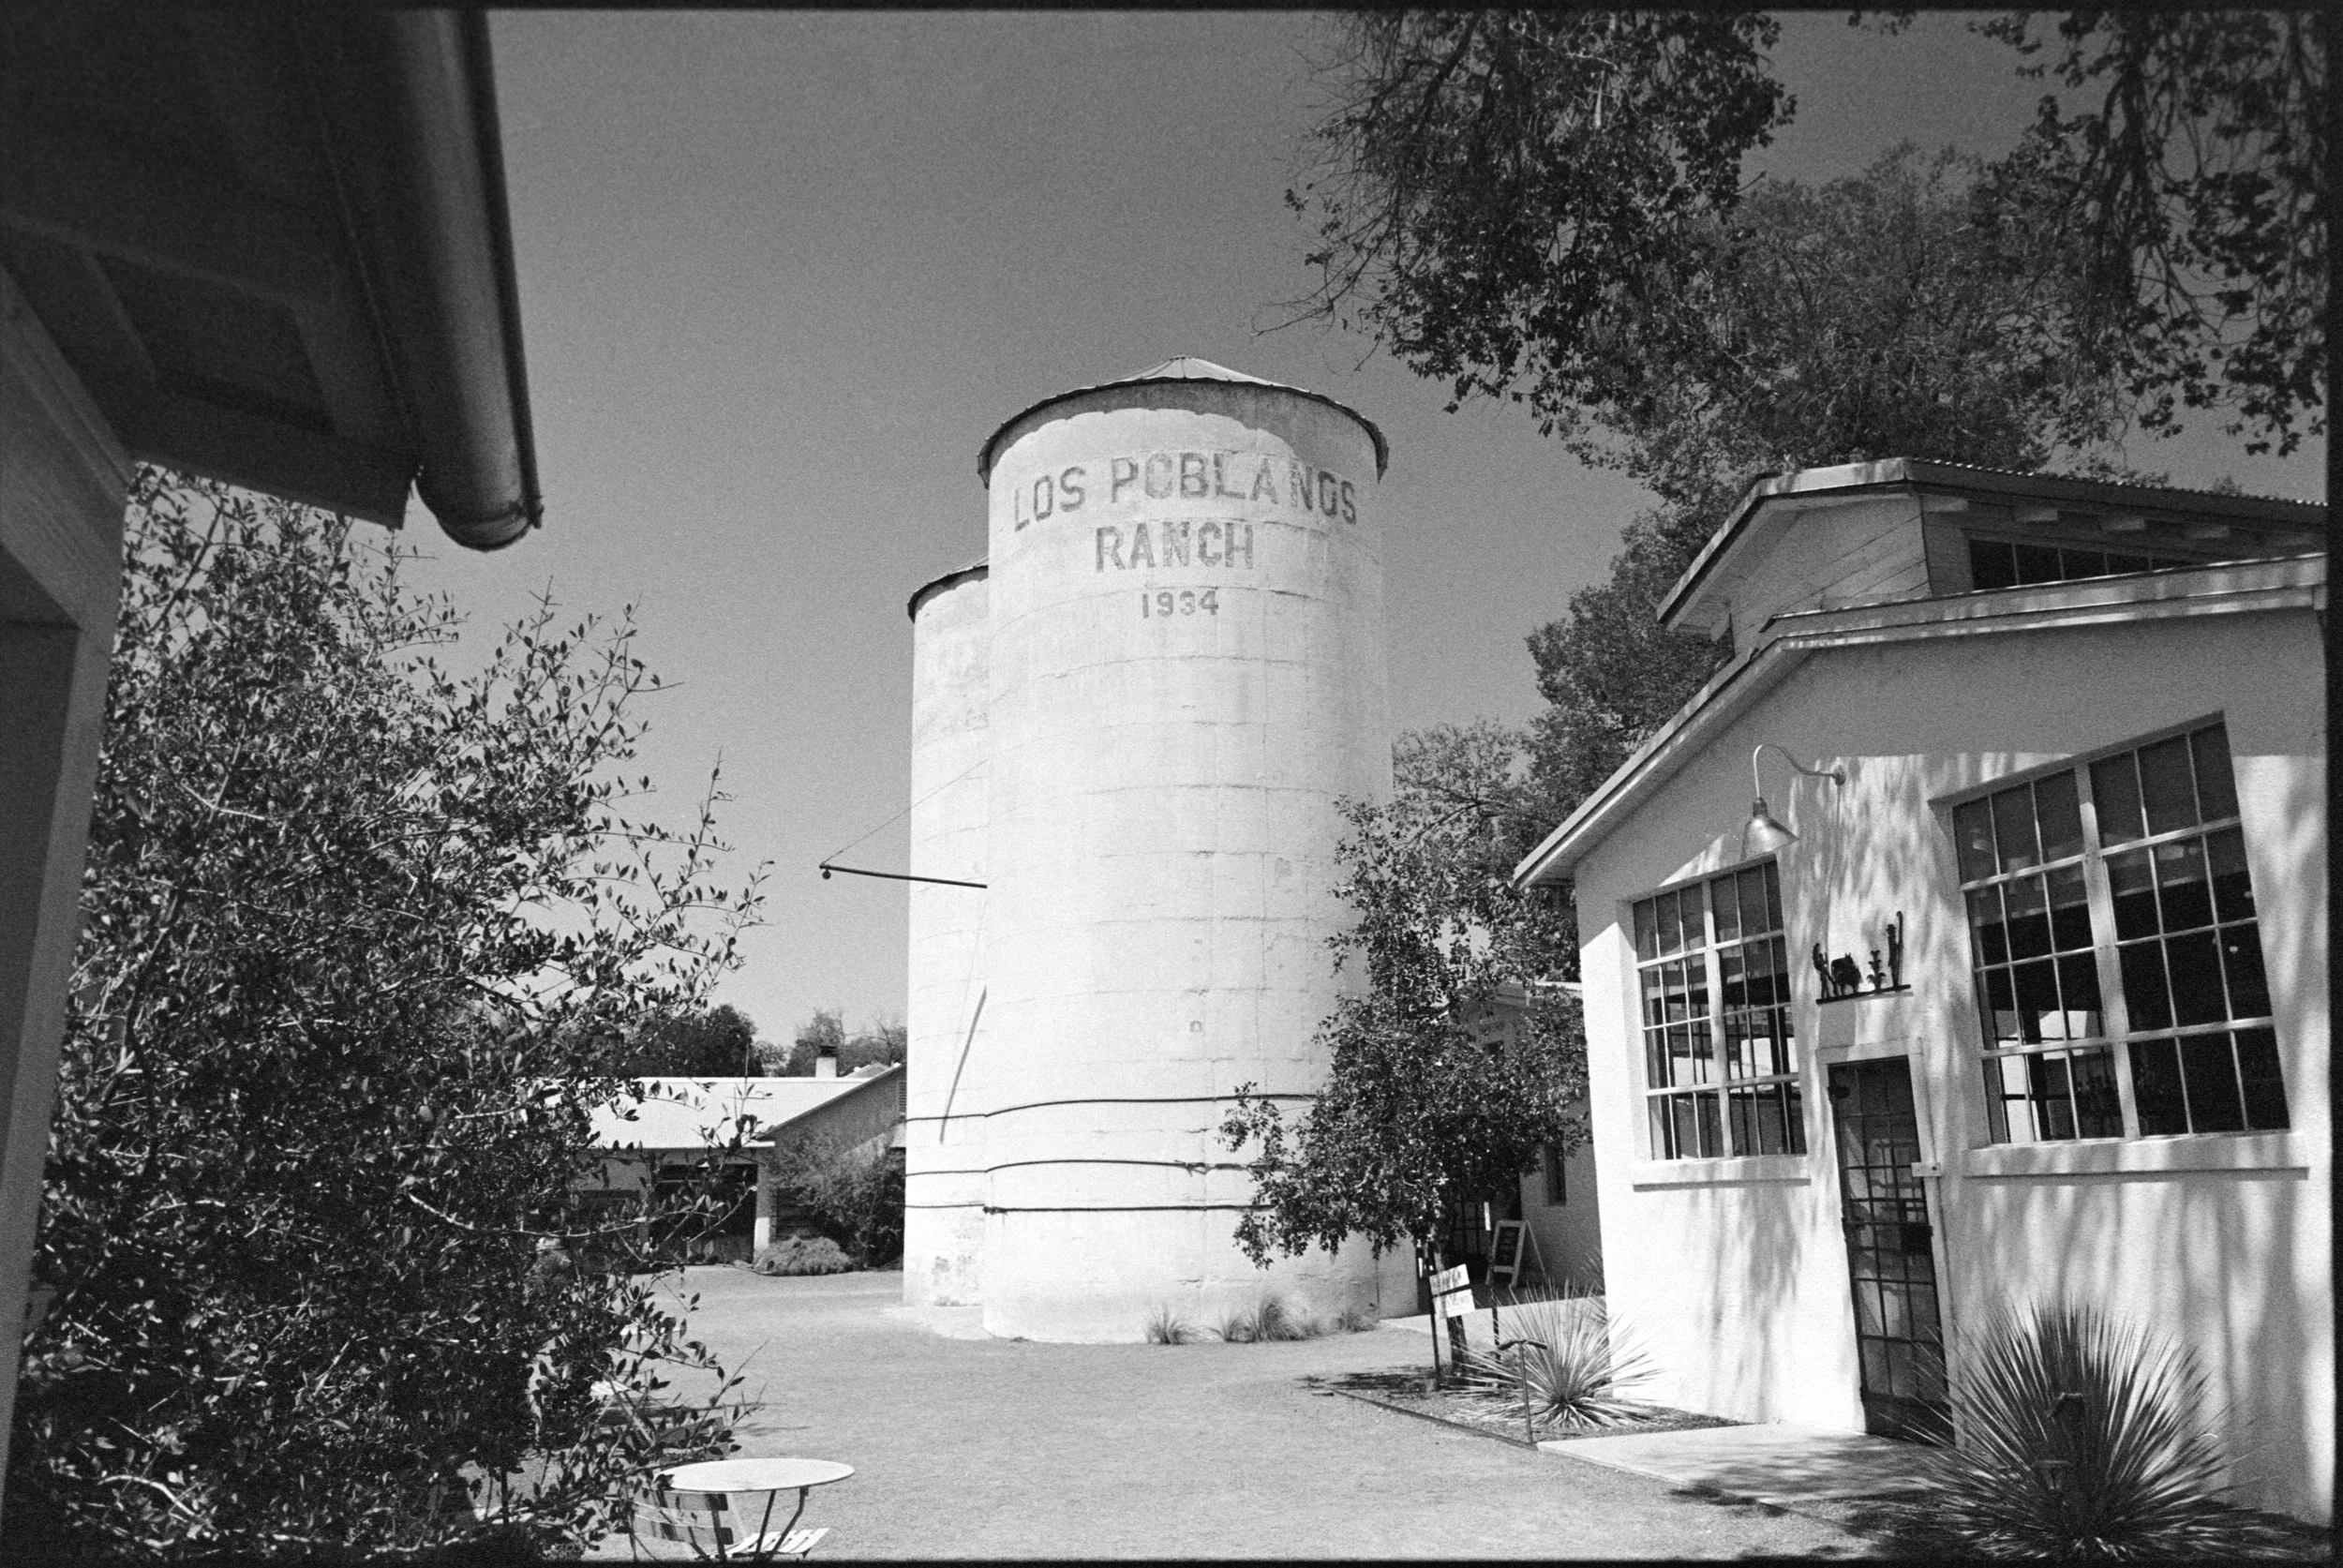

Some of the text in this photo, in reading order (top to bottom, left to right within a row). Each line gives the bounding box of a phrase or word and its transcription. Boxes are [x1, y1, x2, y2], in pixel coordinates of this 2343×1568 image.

[1014, 453, 1358, 531] LOS POBLANOS
[1096, 521, 1254, 573] RANCH
[1142, 590, 1219, 618] 1934
